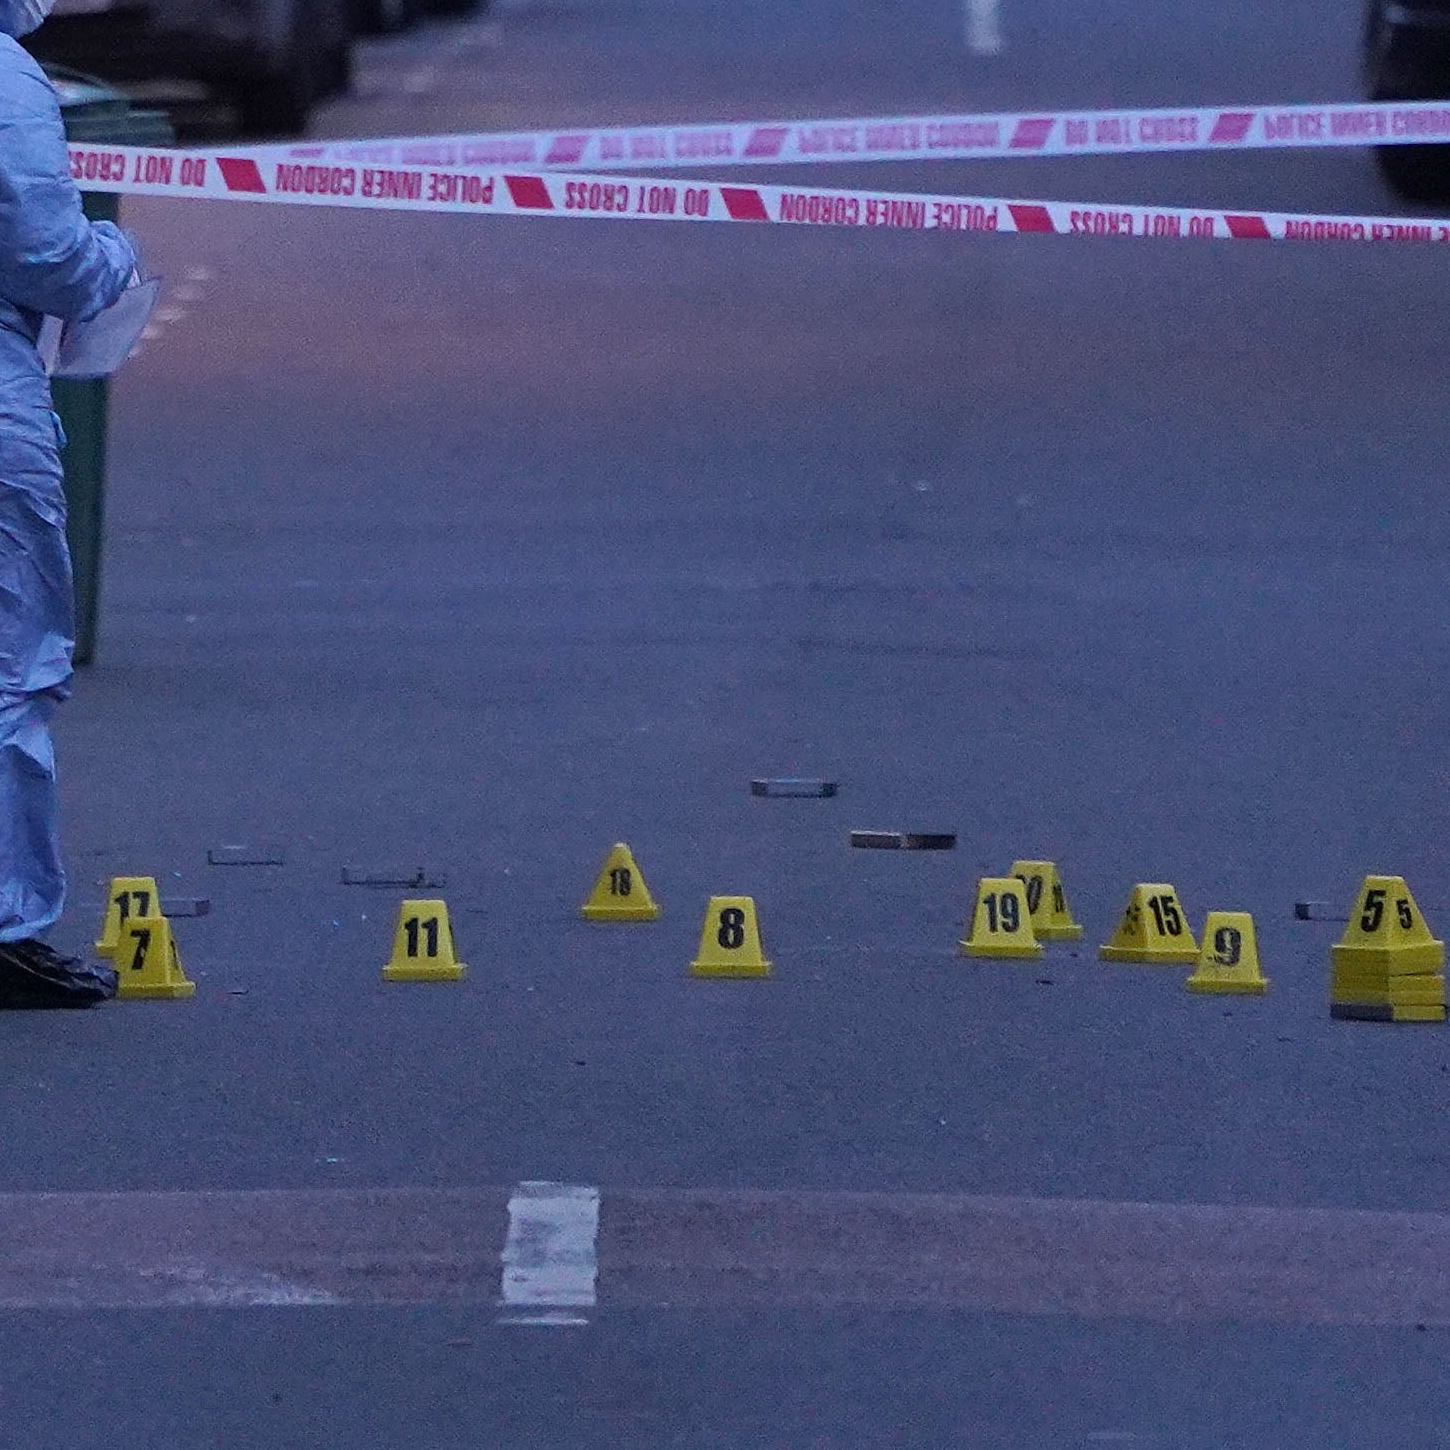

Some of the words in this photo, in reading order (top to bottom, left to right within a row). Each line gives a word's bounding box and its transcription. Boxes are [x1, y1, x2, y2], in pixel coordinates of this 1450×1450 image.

[133, 155, 173, 185] NOT
[181, 158, 206, 187] DO
[276, 164, 355, 196] CORDON
[362, 169, 422, 199] INNER
[427, 173, 495, 204] POLICE
[565, 181, 629, 211] CROSS
[637, 185, 676, 215] NOT
[684, 188, 709, 217] DO
[779, 194, 860, 225] CORDON
[866, 198, 926, 229] INNER
[932, 202, 999, 231] POLICE
[610, 867, 631, 896] 18
[114, 891, 150, 924] 17
[983, 893, 1019, 933] 19
[1148, 895, 1182, 936] 15
[1360, 890, 1386, 933] 5
[1397, 898, 1414, 931] 5
[404, 917, 440, 958] 11
[717, 907, 746, 950] 8
[130, 929, 151, 970] 7
[1213, 928, 1242, 966] 9
